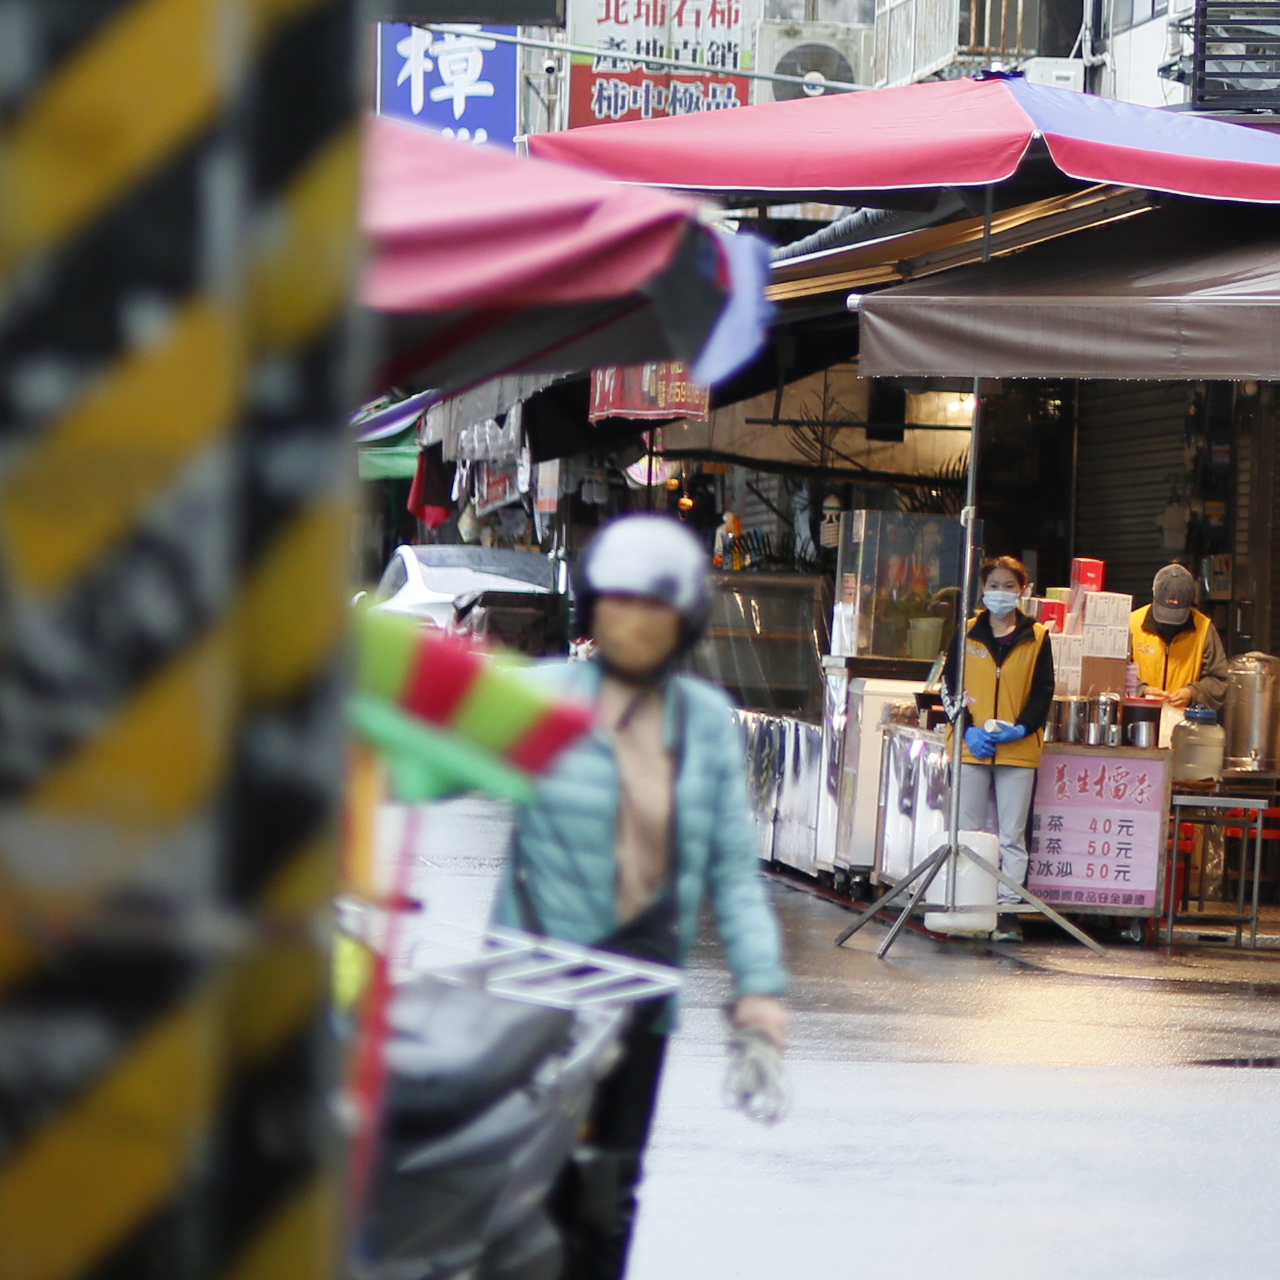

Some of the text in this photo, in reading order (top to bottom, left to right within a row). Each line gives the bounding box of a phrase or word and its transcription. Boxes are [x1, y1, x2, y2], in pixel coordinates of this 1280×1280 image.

[592, 36, 741, 77] 產地直銷
[591, 78, 741, 119] 柿中極品
[1050, 764, 1152, 804] 養生擂茶
